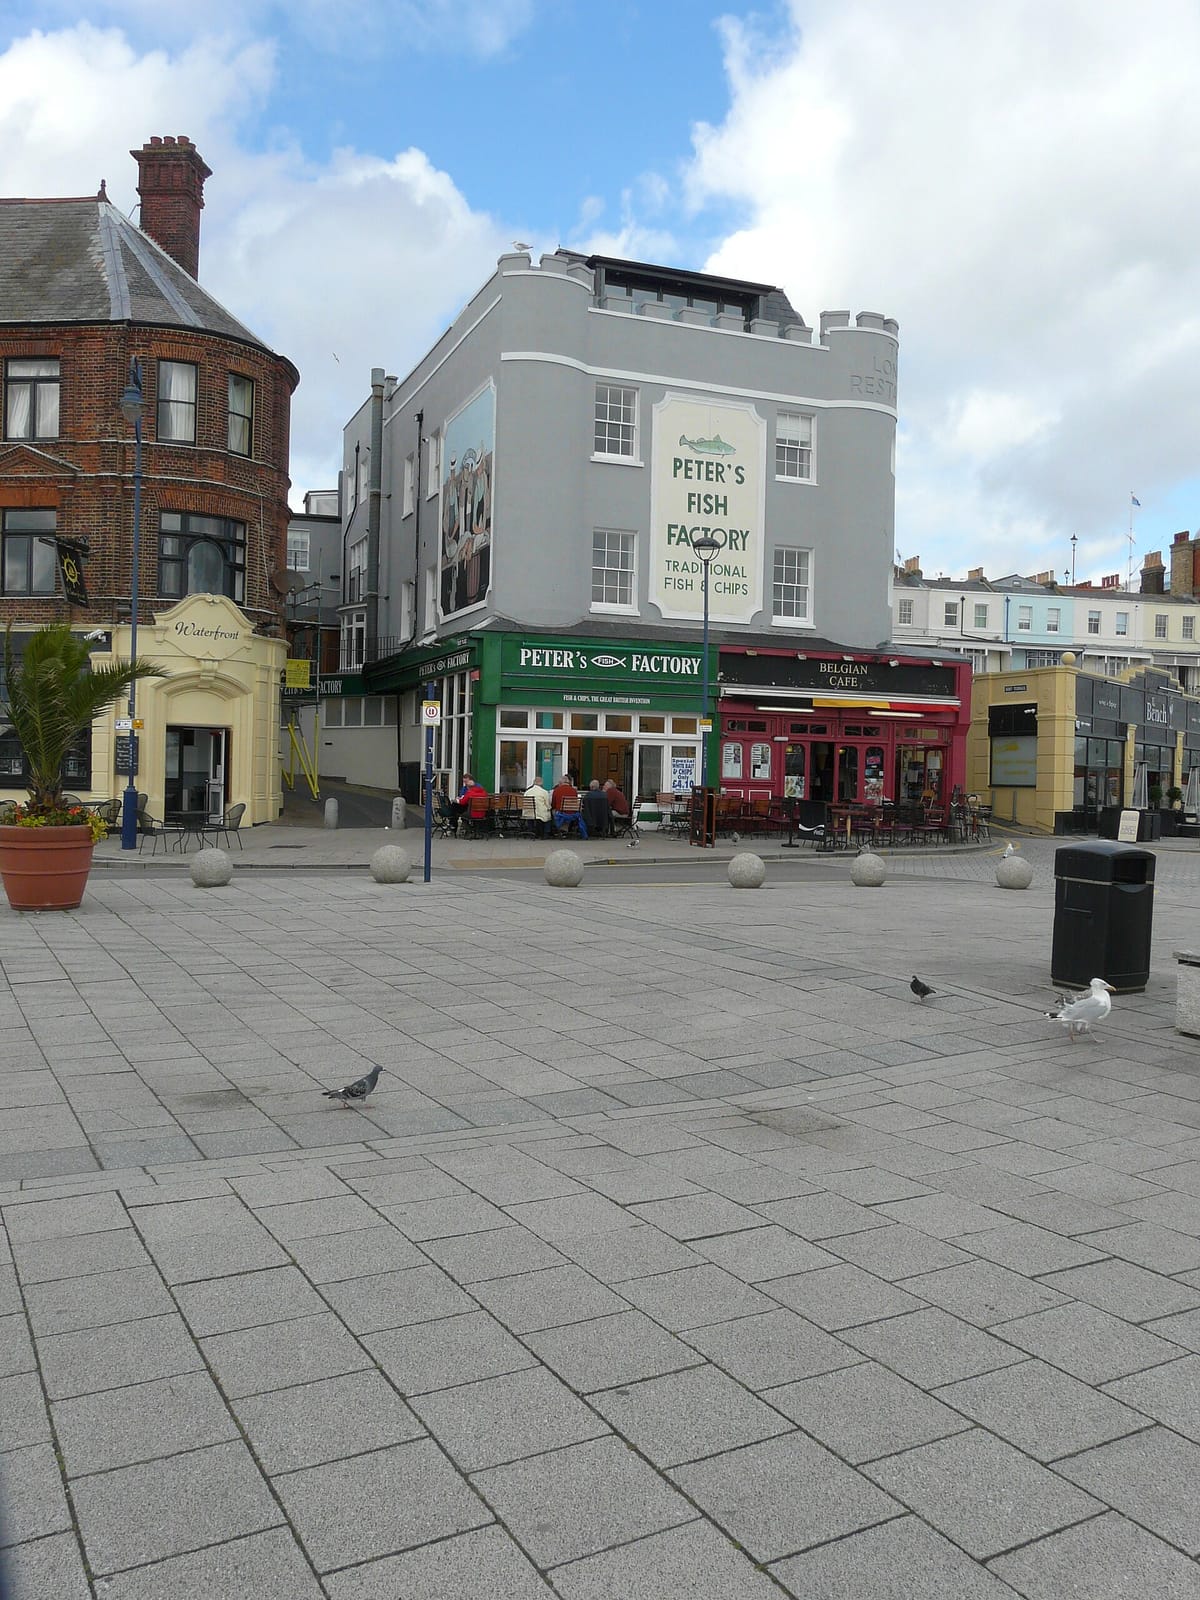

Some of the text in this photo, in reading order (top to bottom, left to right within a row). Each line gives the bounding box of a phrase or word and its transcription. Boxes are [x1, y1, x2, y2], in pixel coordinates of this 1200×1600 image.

[673, 457, 745, 485] PETER'S
[687, 492, 728, 516] FISH
[665, 560, 747, 578] TRADIIONAL
[664, 577, 693, 591] FISH
[714, 582, 748, 595] CHIPS
[175, 621, 239, 640] Waterfront
[631, 654, 701, 674] FACTORY
[819, 662, 868, 674] BELGIAN
[829, 675, 858, 687] CAFE
